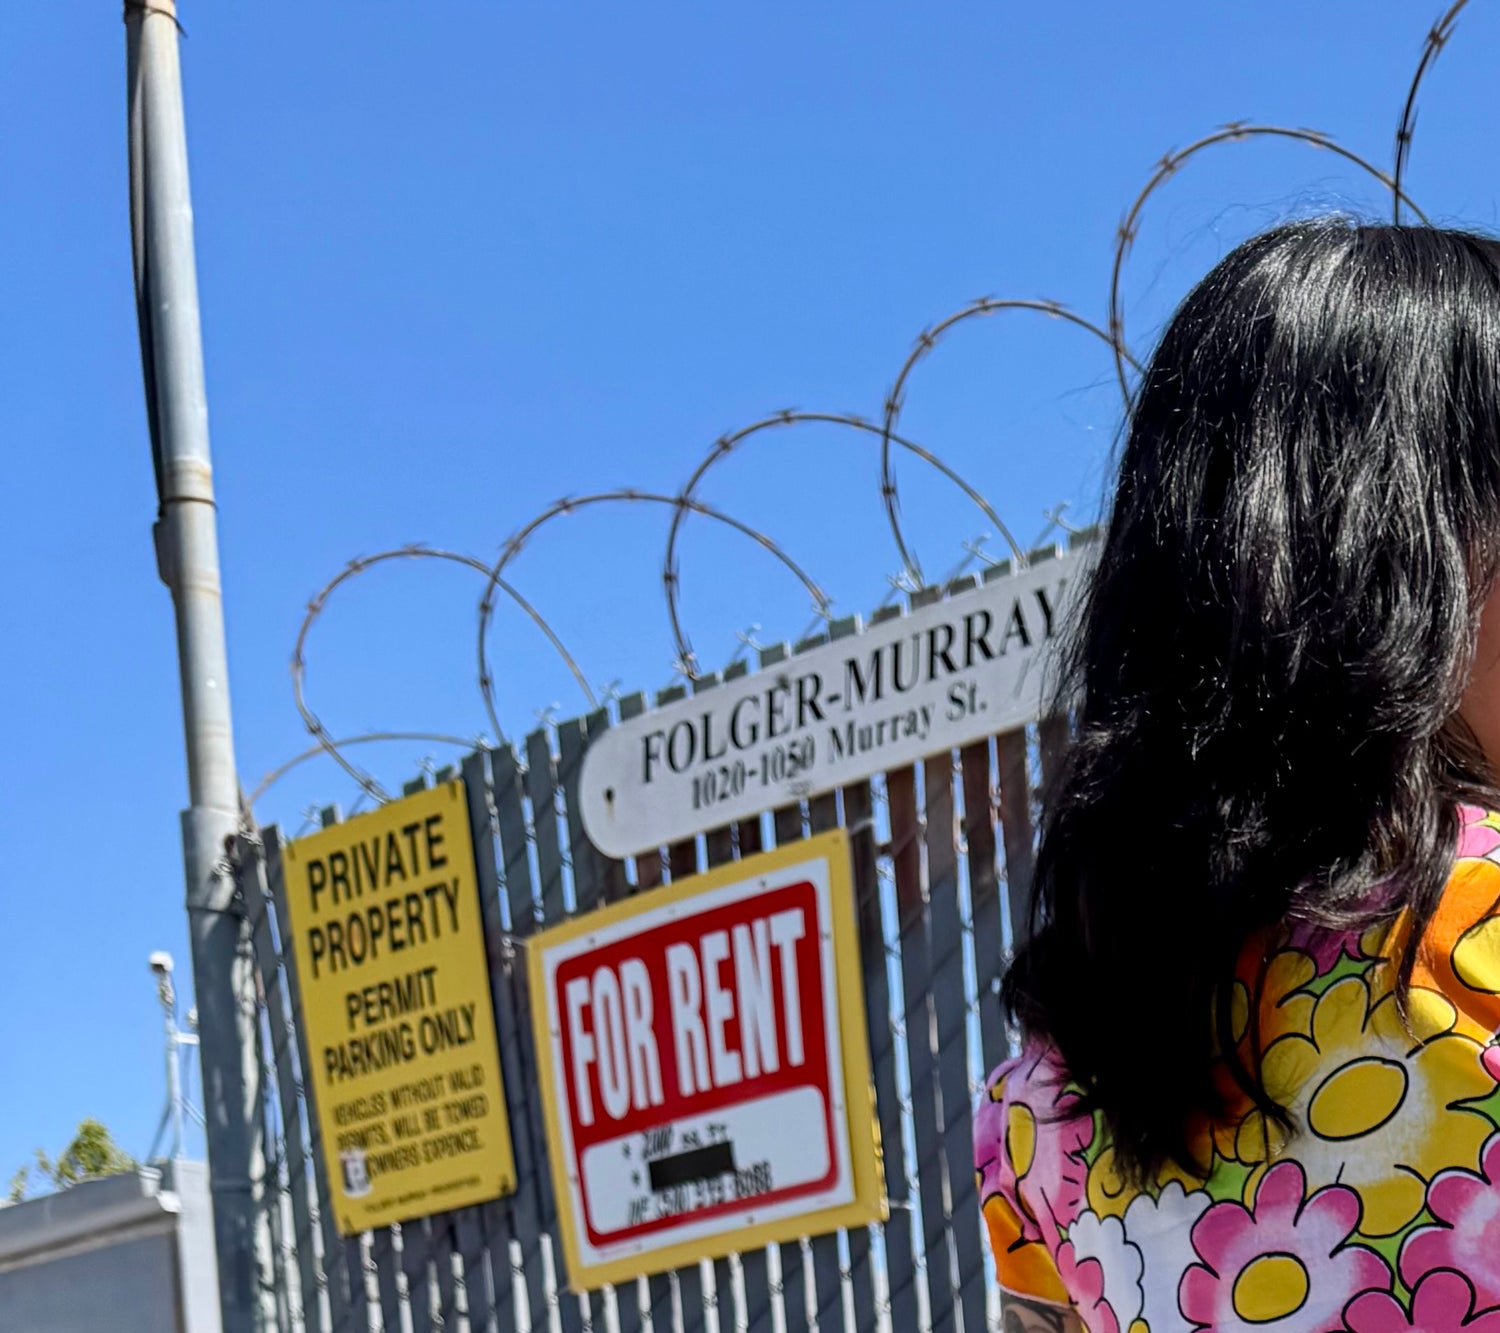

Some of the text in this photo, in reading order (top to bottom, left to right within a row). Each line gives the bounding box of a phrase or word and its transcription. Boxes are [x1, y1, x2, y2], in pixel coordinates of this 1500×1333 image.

[828, 703, 935, 762] Murray
[946, 679, 988, 722] St.
[307, 813, 448, 913] PRIVATE
[308, 876, 459, 980] PROPERTY
[325, 1002, 475, 1086] PARKING ONLY
[346, 966, 437, 1032] PERMIT
[565, 908, 805, 1127] FOR RENT
